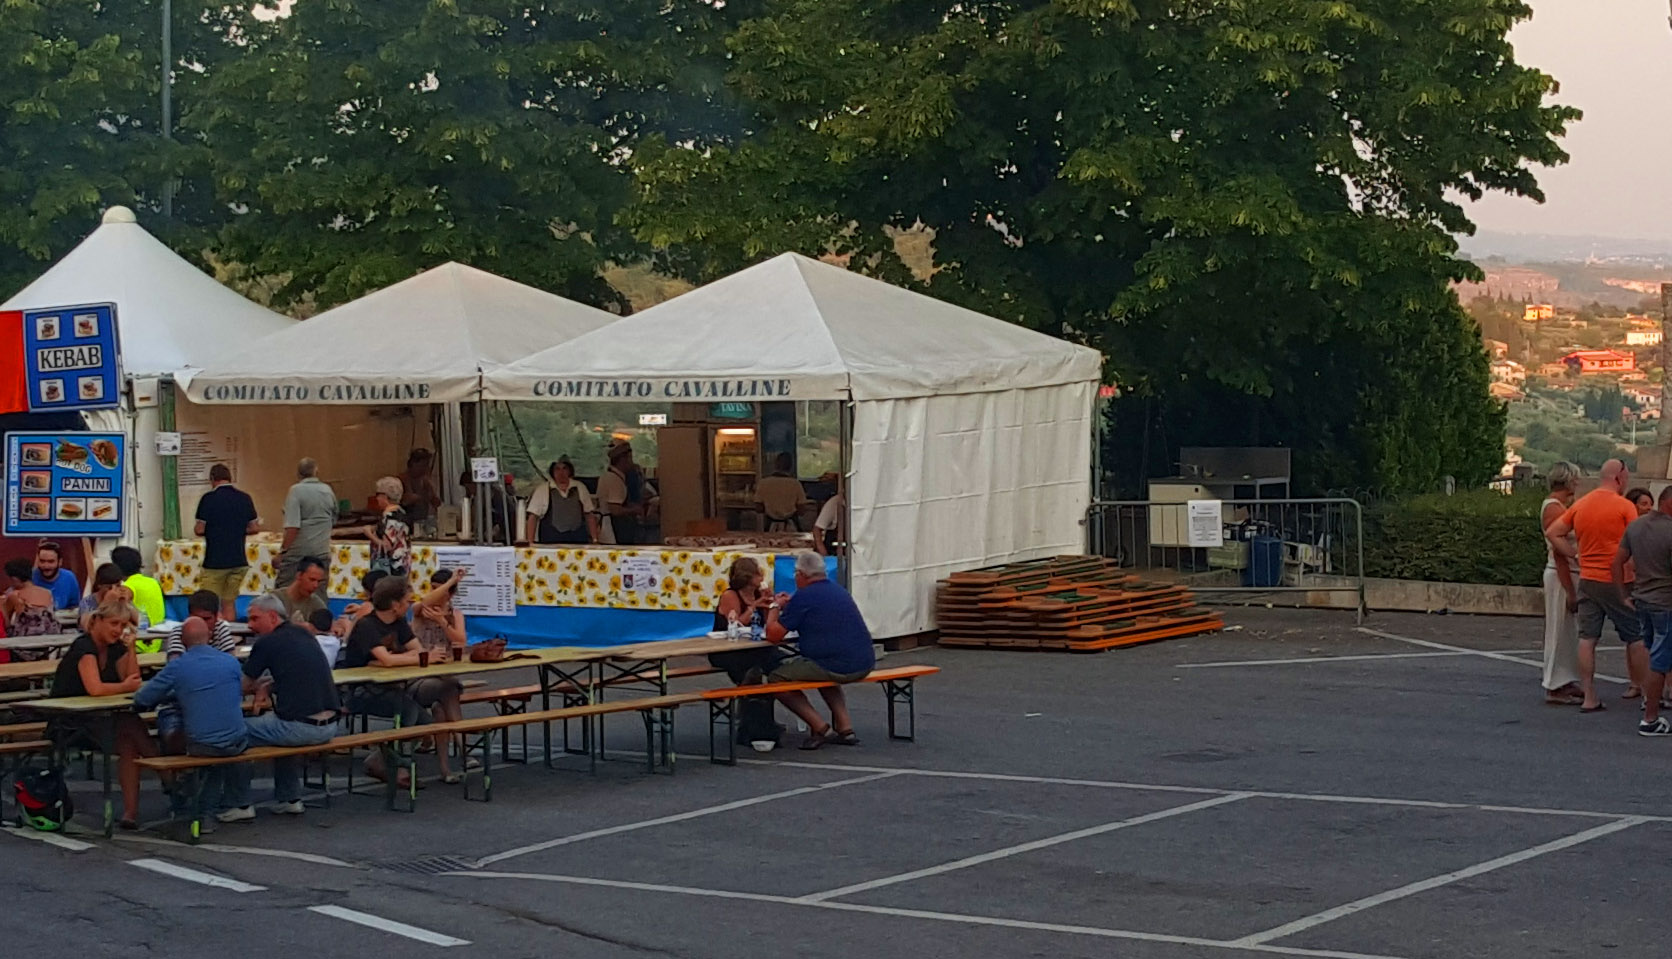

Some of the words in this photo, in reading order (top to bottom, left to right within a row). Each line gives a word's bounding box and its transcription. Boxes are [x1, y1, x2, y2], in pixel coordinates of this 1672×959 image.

[40, 346, 100, 369] KEBAB
[203, 385, 309, 401] COMITATO
[319, 383, 430, 401] CAVALLINE
[533, 379, 652, 397] COMITATO
[664, 379, 792, 397] CAVALLINE
[64, 479, 110, 490] PANINI
